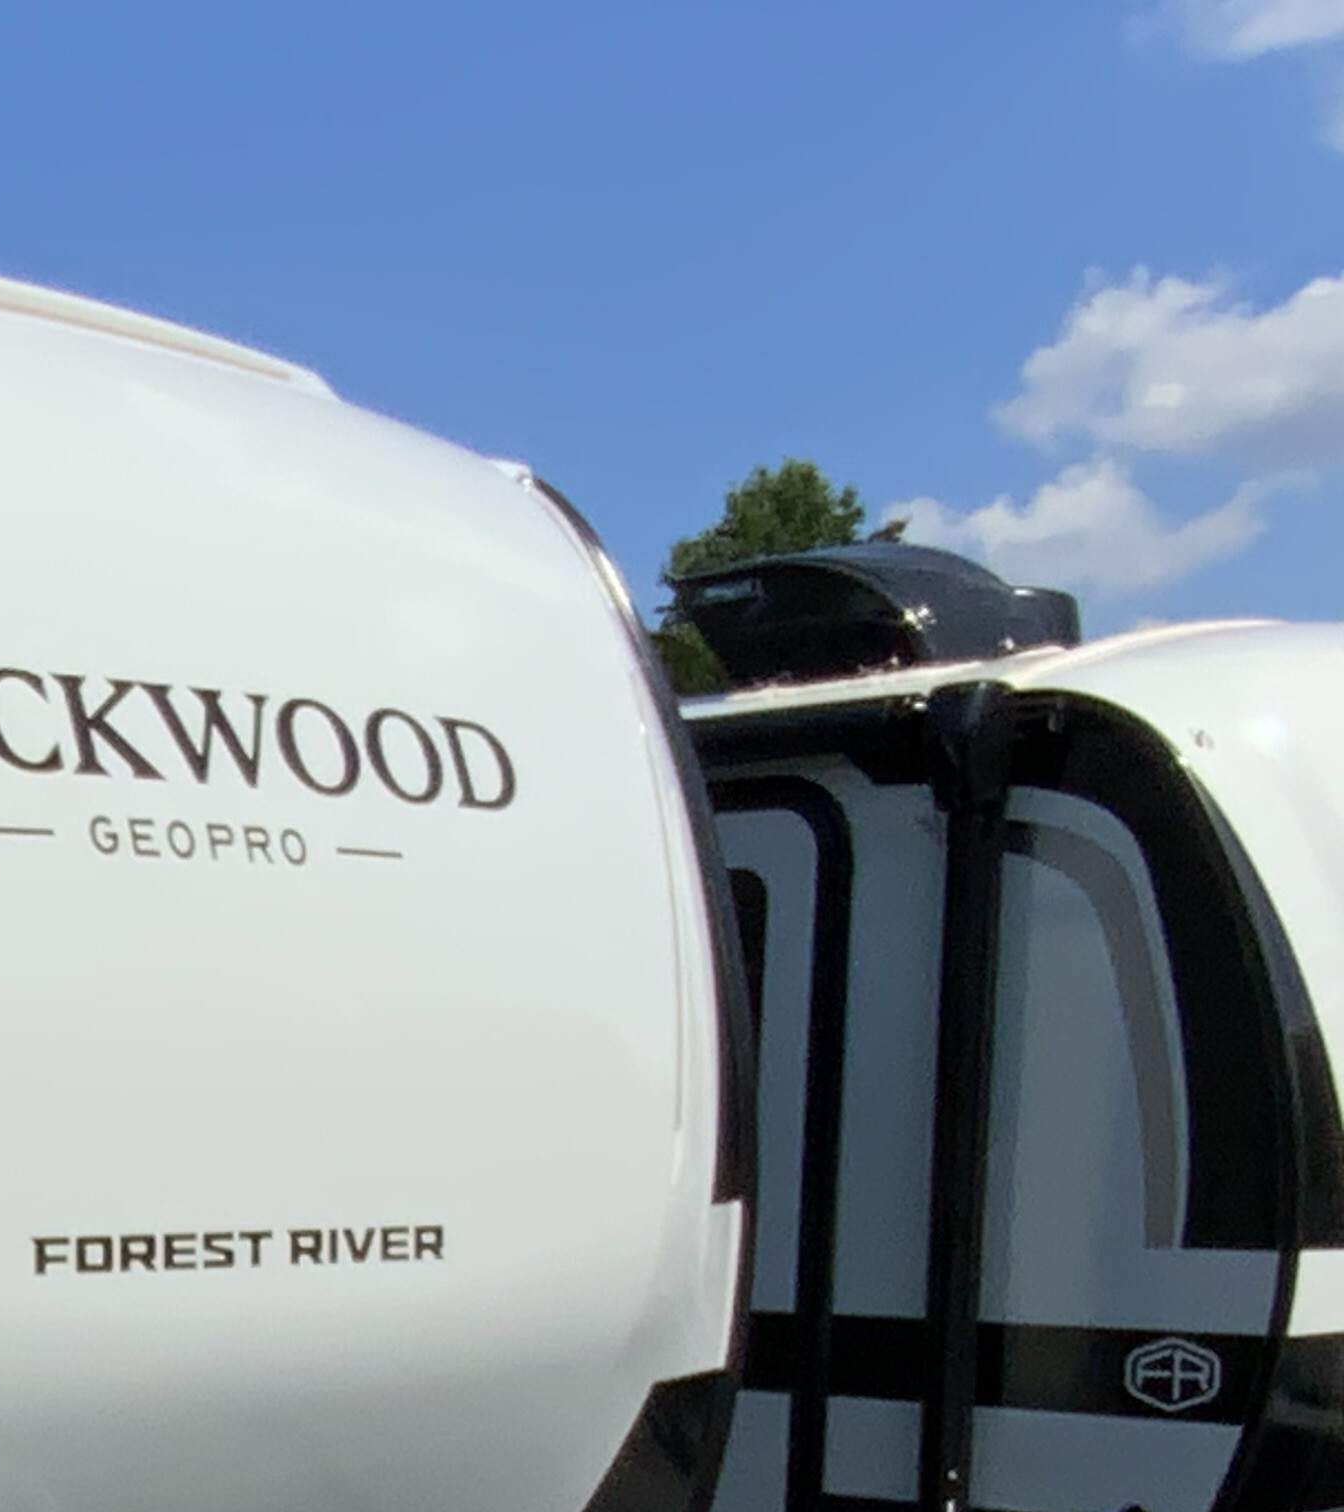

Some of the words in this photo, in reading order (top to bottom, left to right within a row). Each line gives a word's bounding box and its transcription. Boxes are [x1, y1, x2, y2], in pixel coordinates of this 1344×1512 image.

[88, 815, 309, 867] GEOPRO
[31, 1230, 274, 1275] FOREST
[288, 1225, 445, 1266] RIVER
